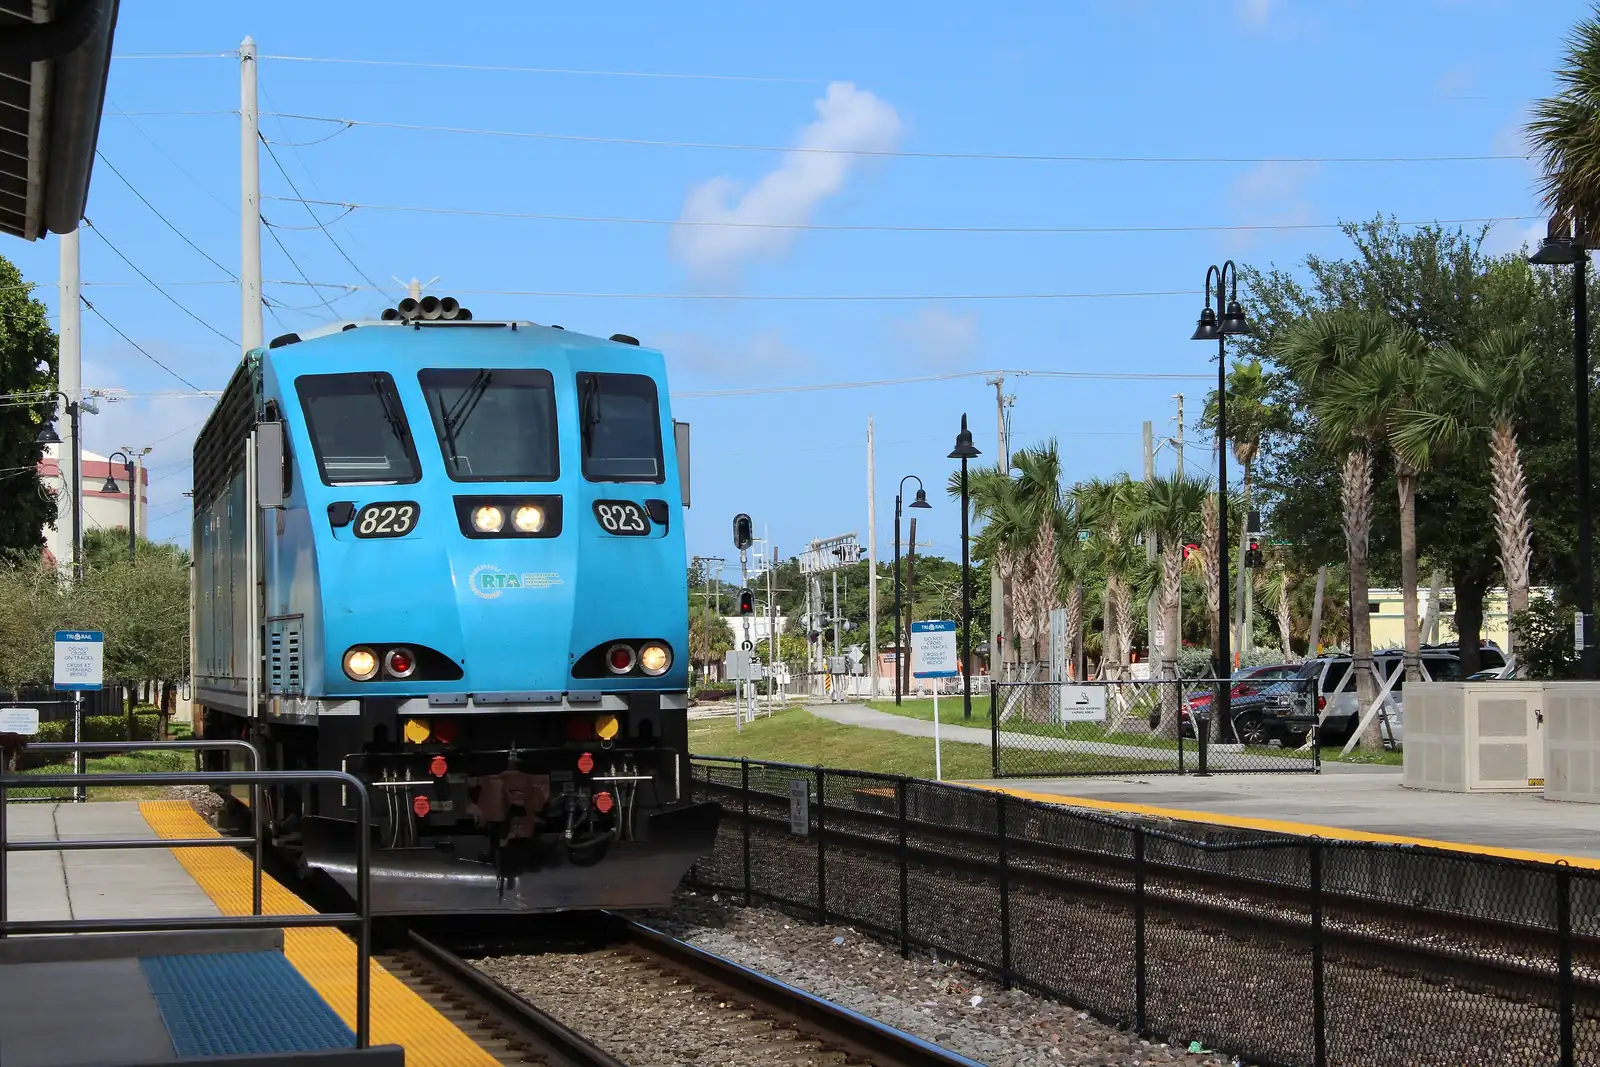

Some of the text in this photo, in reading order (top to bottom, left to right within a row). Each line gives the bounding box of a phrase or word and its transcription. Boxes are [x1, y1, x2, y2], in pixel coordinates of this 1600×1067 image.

[360, 506, 413, 534] 823
[598, 504, 645, 531] 823
[482, 574, 521, 588] RTA
